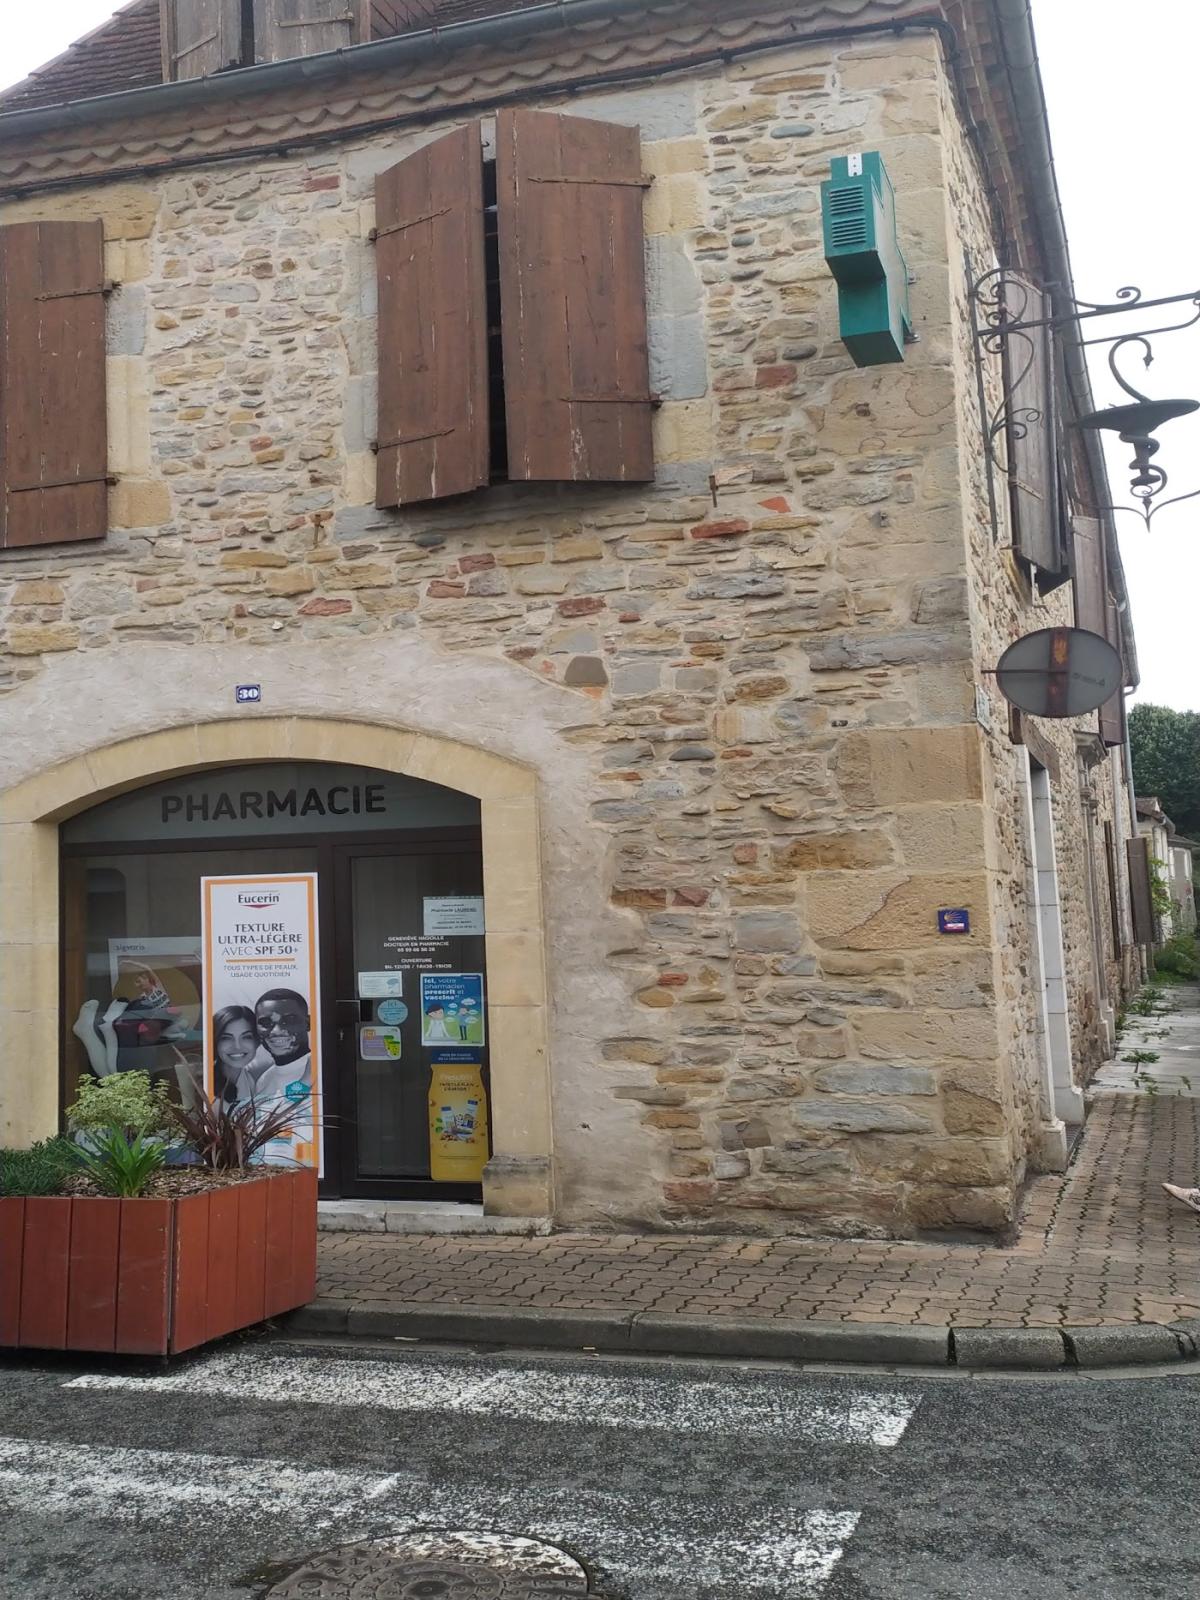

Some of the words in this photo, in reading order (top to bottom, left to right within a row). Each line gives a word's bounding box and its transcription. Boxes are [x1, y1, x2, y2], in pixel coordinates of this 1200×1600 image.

[238, 685, 259, 700] 30
[161, 784, 387, 823] PHARMACIE
[238, 893, 280, 904] Eucerin
[235, 922, 285, 933] TEXTURE
[218, 932, 303, 945] ULTRA-LÉGÈRE
[221, 946, 252, 956] AVEC
[254, 945, 275, 956] SPF
[277, 945, 299, 955] 50+
